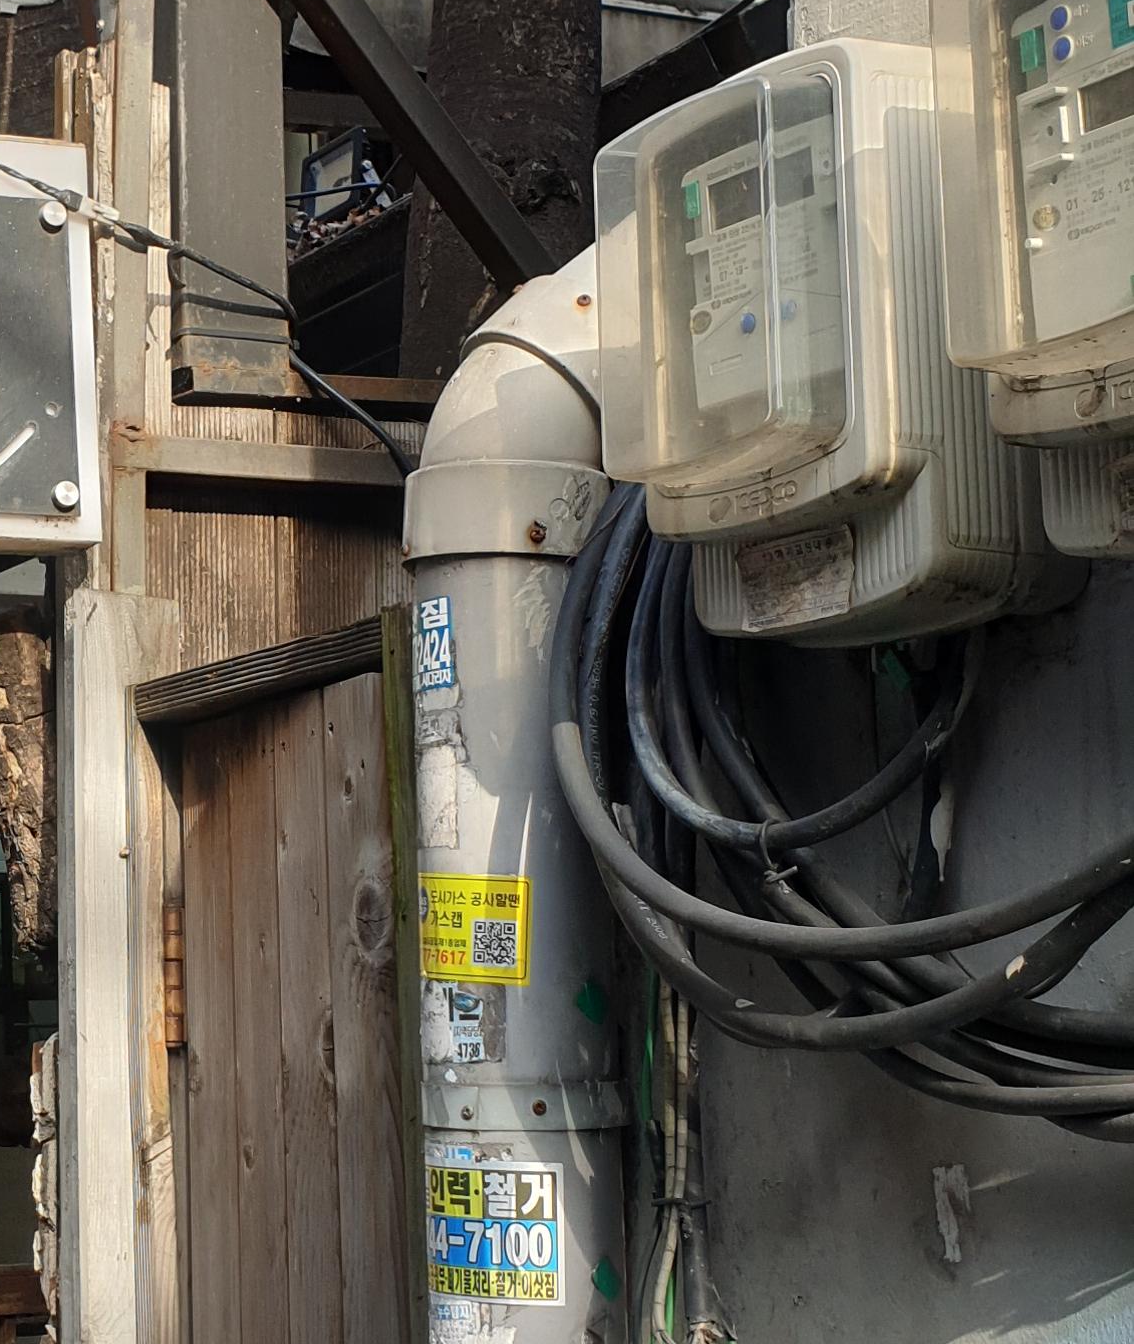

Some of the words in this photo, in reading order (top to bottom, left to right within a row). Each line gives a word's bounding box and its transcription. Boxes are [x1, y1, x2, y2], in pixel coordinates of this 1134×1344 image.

[414, 596, 448, 630] 짐
[414, 627, 451, 674] 2424
[430, 889, 466, 905] 도시가스
